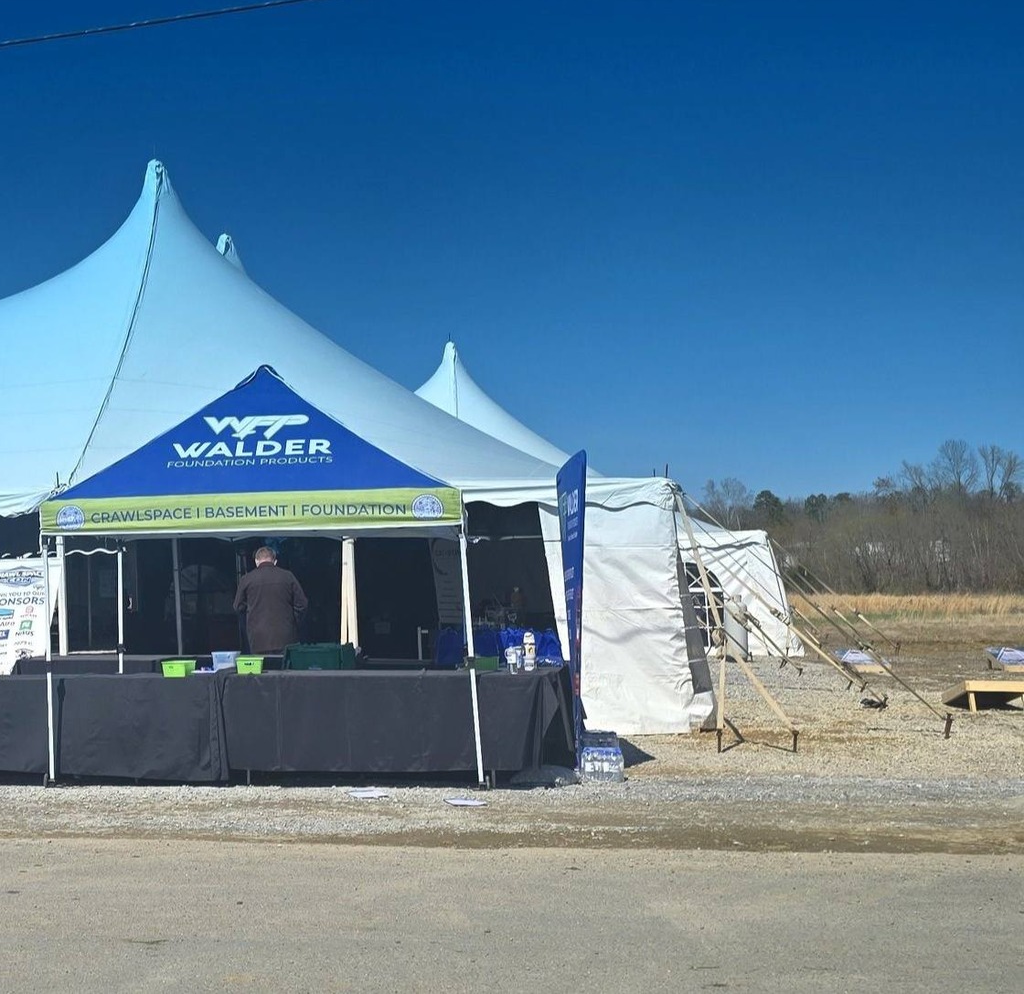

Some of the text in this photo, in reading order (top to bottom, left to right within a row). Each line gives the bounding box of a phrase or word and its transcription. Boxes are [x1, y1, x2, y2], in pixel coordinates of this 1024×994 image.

[173, 439, 333, 459] WALDER
[167, 455, 333, 469] FOUNDATION PRODUCTS
[91, 507, 192, 524] CRAWLSPACE
[205, 504, 288, 519] BASEMENT
[301, 503, 407, 517] FOUNDATION
